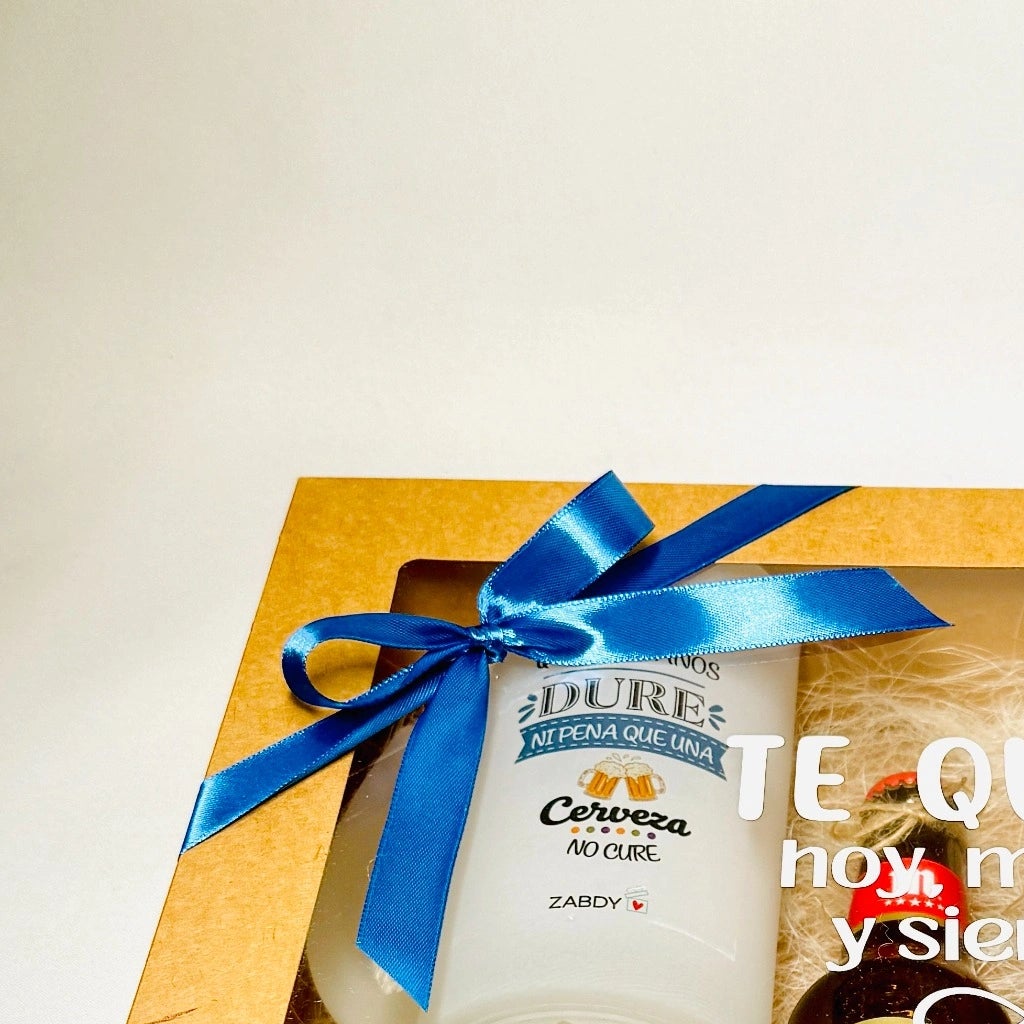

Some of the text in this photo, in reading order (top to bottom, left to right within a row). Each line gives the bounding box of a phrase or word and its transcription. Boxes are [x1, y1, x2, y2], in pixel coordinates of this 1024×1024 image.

[539, 678, 707, 728] DURE
[531, 723, 714, 765] NI PENA QUE UNA
[726, 735, 852, 821] TE
[539, 796, 692, 837] Cerveza
[566, 839, 661, 862] NO CURE
[779, 838, 944, 899] hoy,
[549, 895, 622, 910] ZABDY
[826, 915, 876, 972] y
